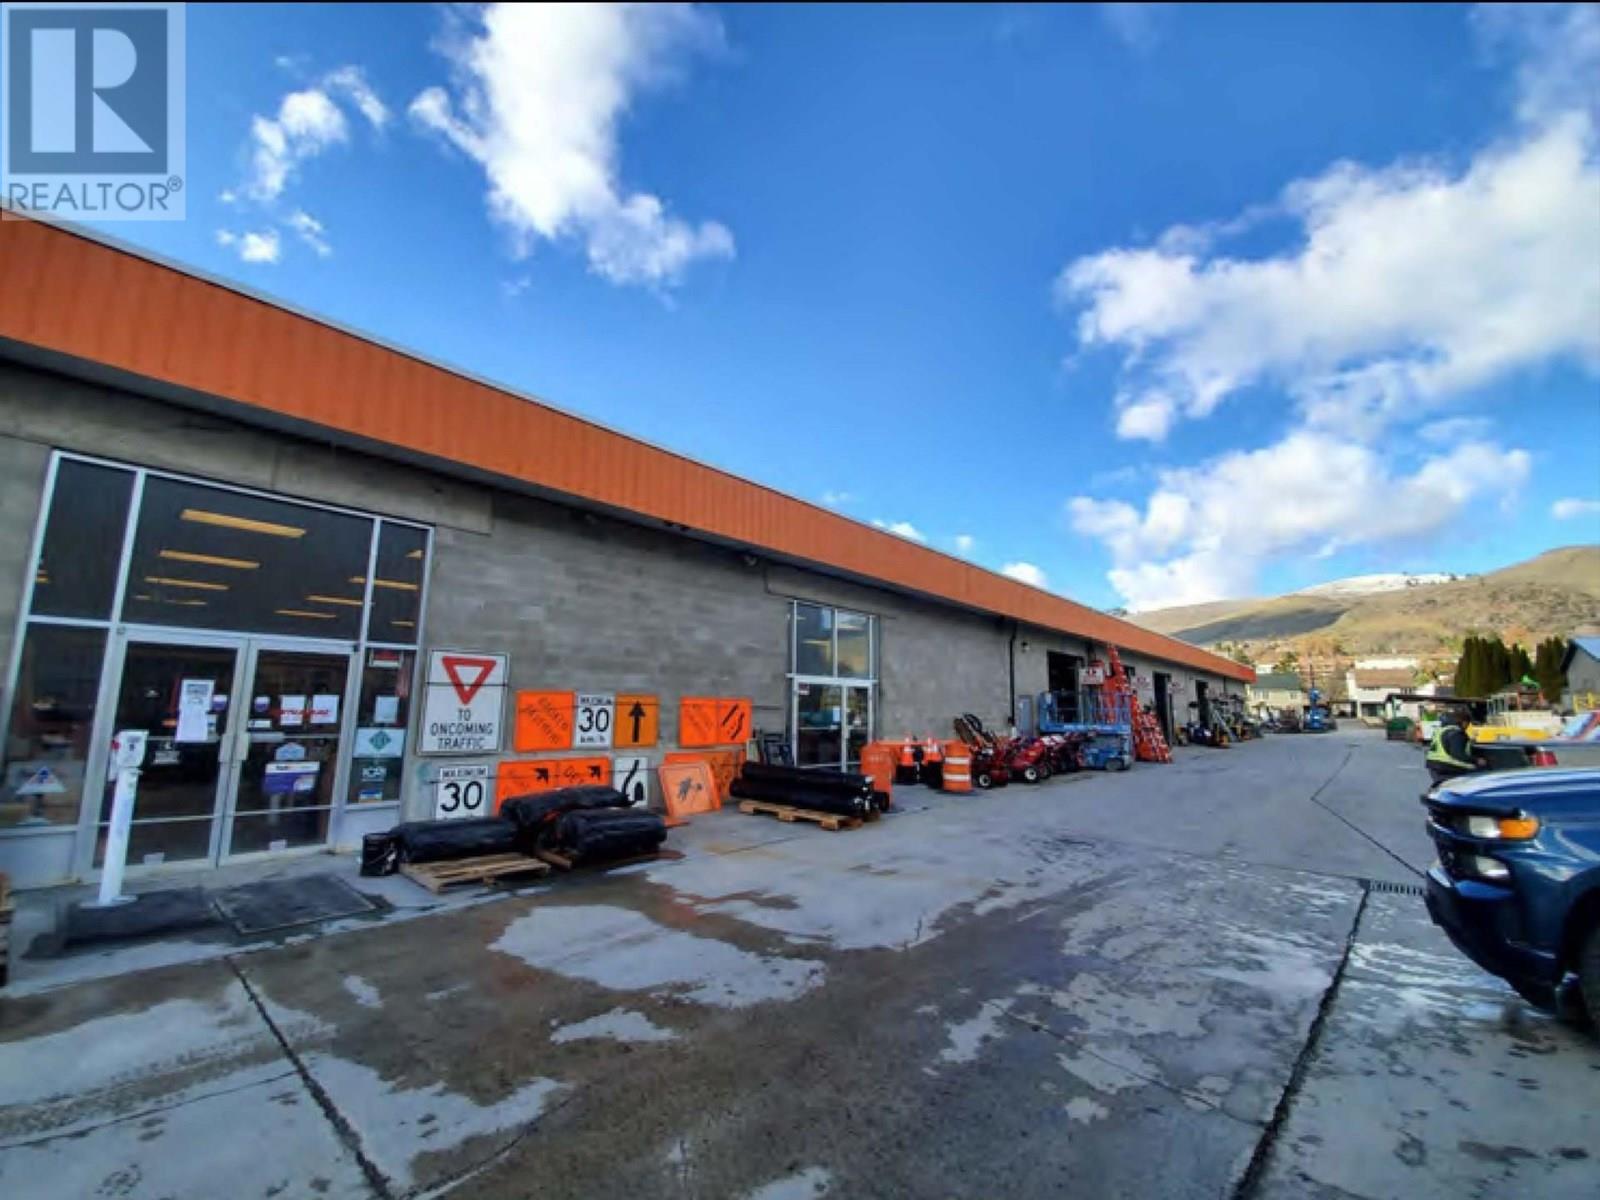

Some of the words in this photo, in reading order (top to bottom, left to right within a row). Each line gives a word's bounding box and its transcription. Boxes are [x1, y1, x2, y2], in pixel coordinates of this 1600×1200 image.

[457, 709, 472, 721] TO
[578, 707, 610, 732] 30
[430, 722, 494, 736] ONCOMING
[438, 737, 485, 749] TRAFFIC
[440, 781, 482, 812] 30
